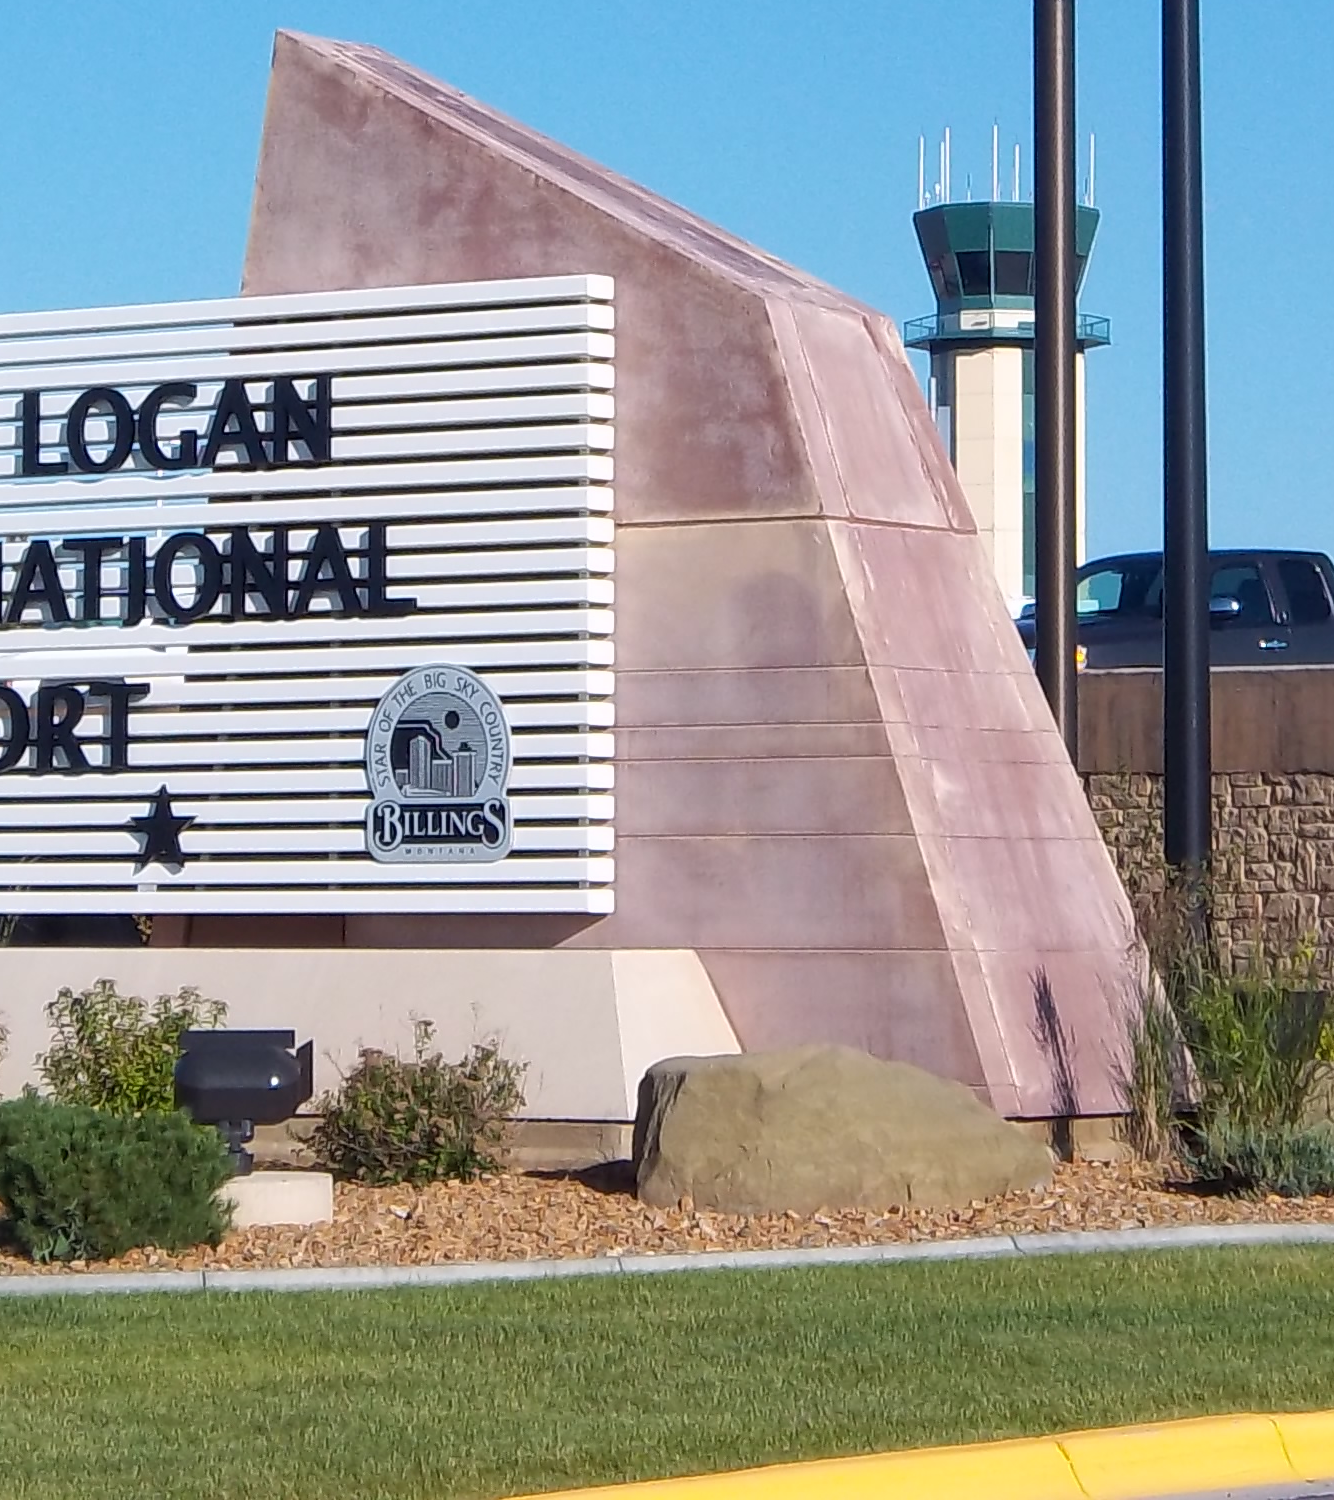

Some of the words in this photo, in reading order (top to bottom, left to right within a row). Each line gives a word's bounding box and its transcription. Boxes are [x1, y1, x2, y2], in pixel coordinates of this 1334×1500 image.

[22, 374, 333, 475] LOGAN
[392, 680, 417, 708] THE
[423, 671, 447, 690] BIG
[453, 676, 480, 699] SKY
[378, 708, 395, 733] OF
[479, 701, 504, 786] COUNTRY
[374, 742, 392, 787] STAR
[374, 798, 506, 851] BILLINGS
[404, 846, 476, 856] MONTANA
